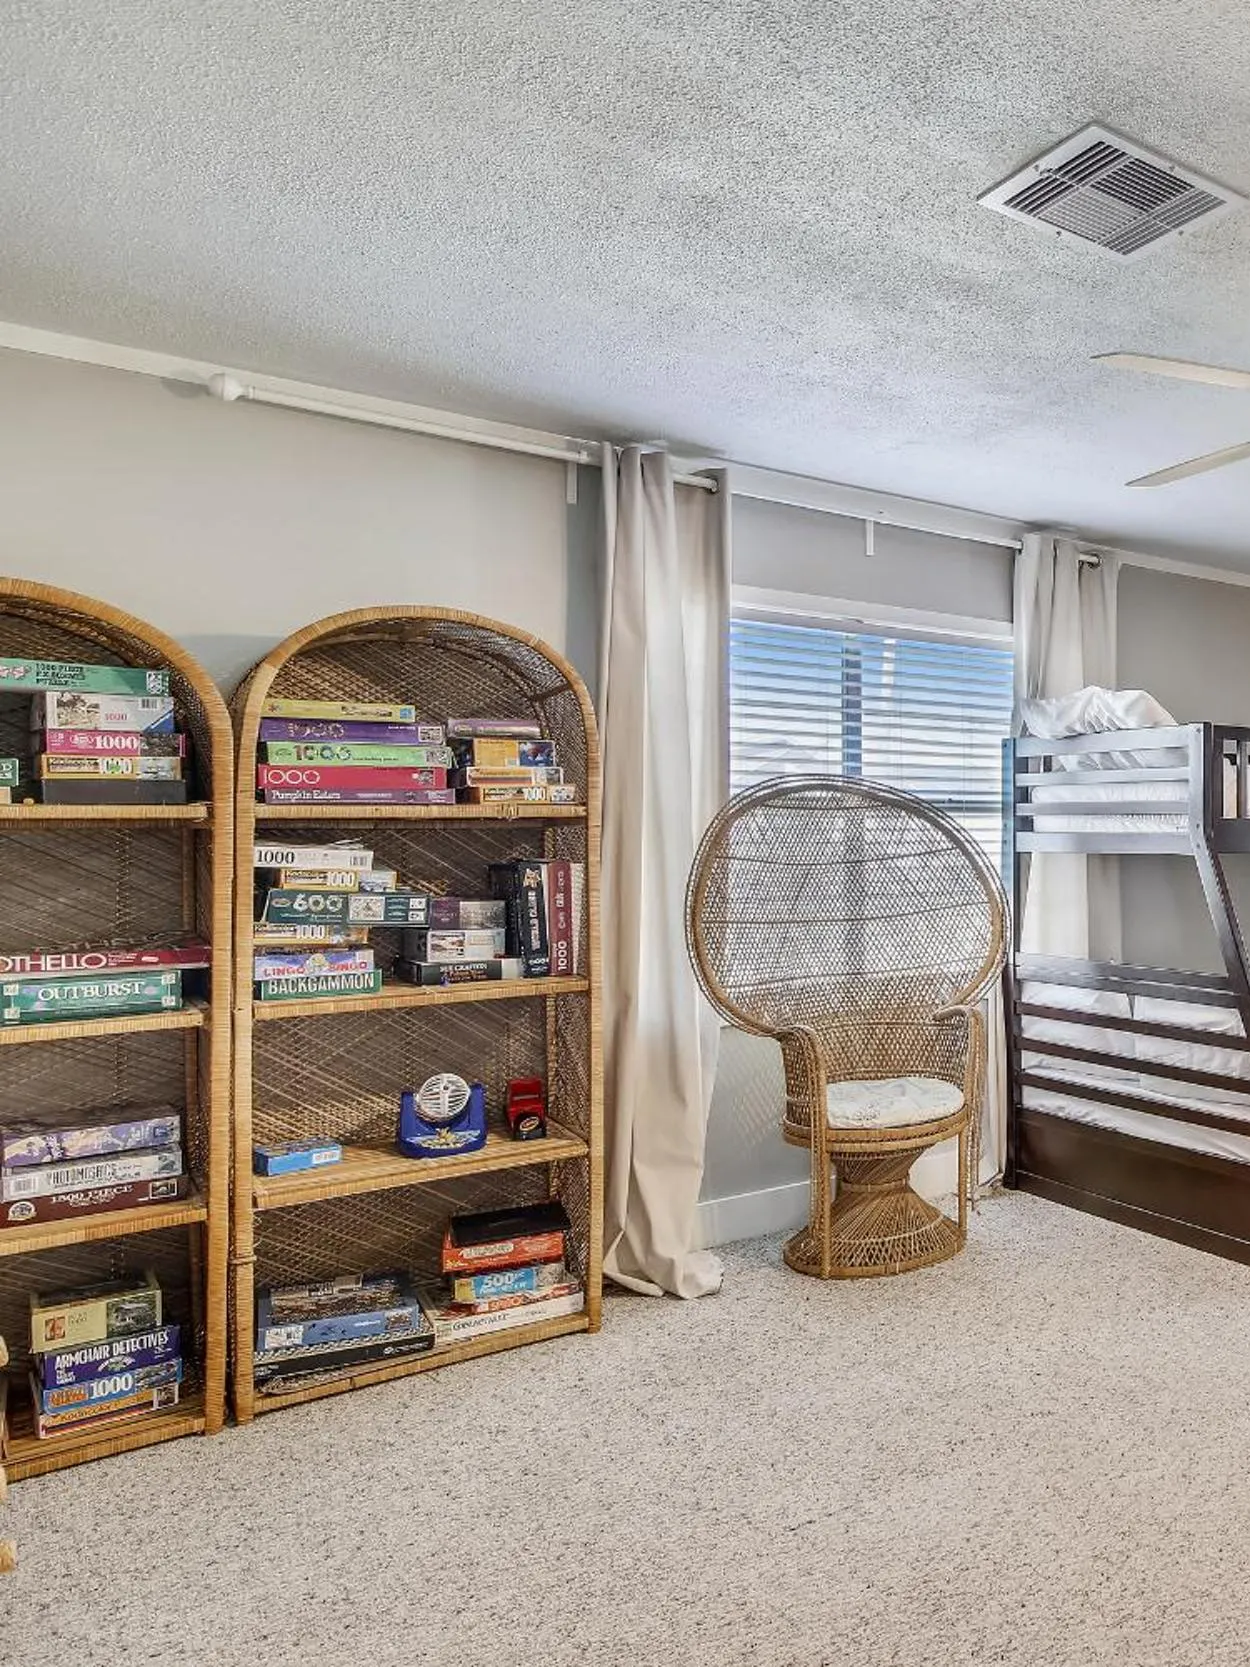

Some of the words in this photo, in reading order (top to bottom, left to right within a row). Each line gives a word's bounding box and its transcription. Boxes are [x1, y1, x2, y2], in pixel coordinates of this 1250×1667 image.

[95, 735, 138, 750] 1000
[263, 769, 320, 785] 1000
[257, 850, 295, 865] 1000
[326, 872, 355, 887] 1000
[292, 894, 343, 912] 600
[296, 924, 326, 939] 1000
[557, 940, 568, 971] 1000
[38, 981, 145, 1001] OUTBURST
[268, 973, 375, 994] BACKGAMMON
[484, 1272, 513, 1289] 500
[55, 1345, 110, 1370] ARMCHAIR
[112, 1330, 169, 1356] DETECTIVES
[90, 1373, 134, 1400] 1000
